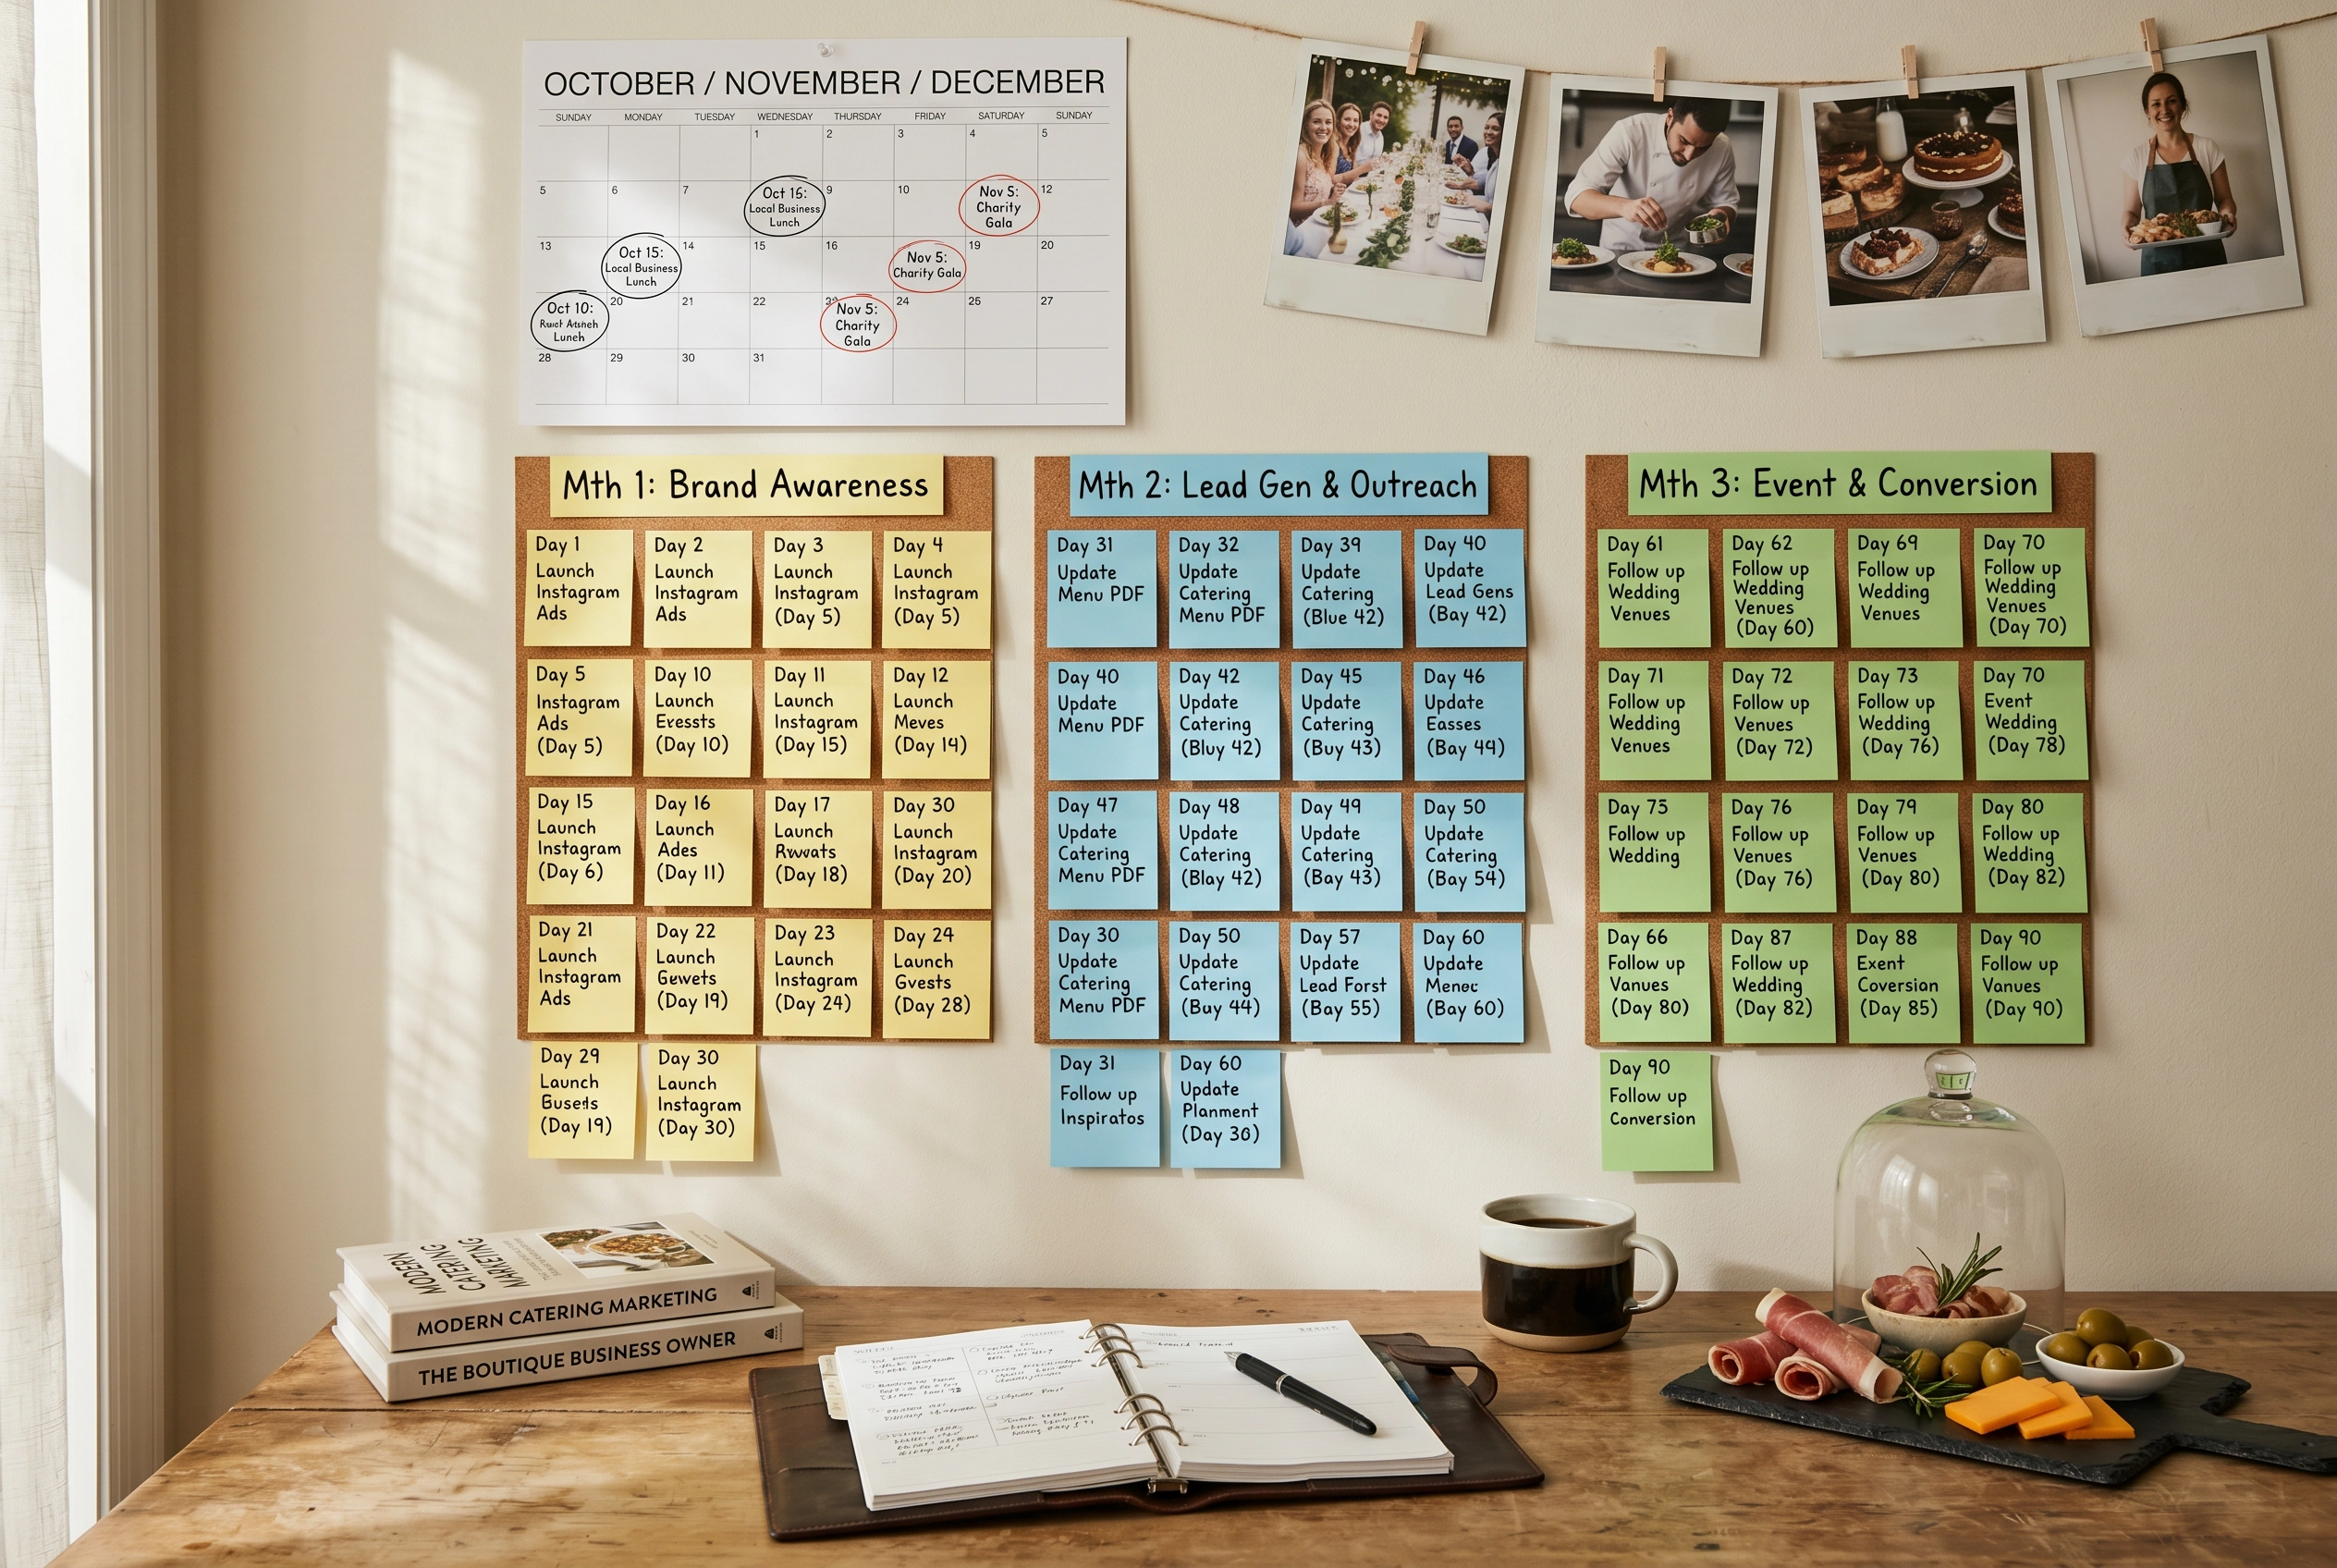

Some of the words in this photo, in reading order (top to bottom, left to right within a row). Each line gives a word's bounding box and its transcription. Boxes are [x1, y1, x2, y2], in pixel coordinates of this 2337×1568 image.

[545, 72, 694, 96] OCTOBER
[727, 71, 899, 95] NOVEMBER
[933, 69, 1104, 93] DECEMBER
[556, 113, 592, 122] SUNDAY
[624, 113, 663, 122] MONDAY
[694, 112, 736, 121] TUESDAY
[757, 112, 814, 121] WEDNESDAY
[833, 112, 883, 121] THURSDAY
[914, 112, 947, 121] FRIDAY
[978, 111, 1025, 120] SATURDAY
[1056, 111, 1094, 120] SUNDAY
[754, 129, 759, 139] 1
[826, 129, 833, 139] 2
[898, 129, 904, 139] 3
[969, 129, 976, 138] 4
[1041, 128, 1048, 138] 5
[539, 185, 546, 195] 5
[611, 185, 618, 195] 6
[682, 185, 690, 195] 7
[826, 185, 833, 195] 9
[898, 184, 910, 194] 10
[1041, 184, 1053, 194] 12
[750, 203, 775, 214] Local
[778, 203, 821, 214] Business
[976, 202, 1021, 215] Charity
[769, 216, 800, 227] Lunch
[985, 216, 1012, 227] Gala
[540, 240, 552, 251] 13
[619, 246, 642, 258] Oct
[646, 246, 664, 258] 15:
[682, 240, 694, 251] 14
[753, 240, 766, 251] 15
[826, 240, 838, 251] 16
[969, 240, 981, 251] 19
[1041, 239, 1054, 250] 20
[907, 251, 932, 263] Nov
[936, 251, 948, 263] 5:
[606, 263, 632, 273] Local
[635, 263, 679, 273] Business
[893, 267, 934, 280] Charity
[937, 267, 961, 278] Gala
[626, 276, 657, 287] Lunch
[610, 296, 623, 306] 20
[681, 296, 693, 306] 21
[752, 296, 766, 306] 22
[837, 302, 861, 314] Nov
[865, 302, 877, 314] 5:
[896, 296, 910, 306] 24
[1040, 296, 1054, 306] 27
[836, 320, 880, 334] Charity
[844, 336, 871, 347] Gala
[538, 352, 552, 362] 28
[610, 352, 624, 362] 29
[681, 352, 695, 362] 30
[564, 470, 621, 499] Mth
[636, 471, 655, 499] 1:
[670, 469, 756, 498] Brand
[771, 468, 928, 498] Awareness
[1080, 471, 1132, 499] Mth
[1146, 471, 1170, 498] 2:
[1184, 470, 1246, 498] Lead
[1260, 470, 1310, 498] Gen
[1323, 470, 1339, 498] &
[1352, 470, 1476, 498] Outreach
[1641, 469, 1697, 498] Mth
[1712, 468, 1740, 497] 3:
[1755, 468, 1836, 497] Event
[1849, 468, 1866, 496] &
[1879, 467, 2037, 496] Conversion
[536, 536, 567, 557] Day
[575, 536, 579, 551] 1
[894, 537, 924, 558] Day
[934, 537, 942, 552] 4
[1058, 537, 1089, 558] Day
[1097, 537, 1111, 552] 31
[1302, 537, 1332, 558] Day
[1340, 537, 1360, 552] 39
[537, 562, 593, 578] Launch
[895, 563, 952, 579] Launch
[1058, 564, 1116, 584] Update
[1303, 563, 1360, 583] Update
[538, 583, 618, 604] Instagram
[895, 584, 978, 605] Instagram
[1058, 586, 1103, 602] Menu
[1111, 585, 1144, 601] PDF
[1303, 585, 1373, 606] Catering
[537, 605, 567, 619] Ads
[895, 607, 934, 630] (Day
[942, 606, 959, 626] 5)
[1304, 608, 1347, 627] (Blue
[1354, 607, 1384, 627] 42)
[1609, 668, 1640, 689] Day
[1647, 668, 1662, 682] 71
[1984, 668, 2015, 689] Day
[2023, 668, 2044, 682] 70
[1609, 693, 1658, 709] Follow
[1667, 699, 1685, 714] up
[1986, 692, 2033, 707] Event
[1609, 715, 1680, 736] Wedding
[1986, 713, 2056, 735] Wedding
[1611, 737, 1670, 753] Venues
[1989, 735, 2029, 758] (Day
[2036, 735, 2064, 755] 78)
[538, 793, 569, 815] Day
[577, 793, 593, 808] 15
[1302, 799, 1332, 820] Day
[1340, 799, 1360, 814] 49
[1858, 799, 1889, 820] Day
[1896, 799, 1916, 815] 79
[538, 819, 595, 834] Launch
[1302, 825, 1360, 845] Update
[1858, 826, 1908, 841] Follow
[1915, 831, 1934, 846] up
[539, 840, 620, 861] Instagram
[1303, 847, 1373, 867] Catering
[1858, 847, 1916, 863] Venues
[539, 862, 578, 885] (Day
[585, 862, 603, 881] 6)
[1304, 867, 1343, 890] (Bay
[1351, 867, 1380, 888] 43)
[1863, 868, 1903, 891] (Day
[1910, 867, 1939, 888] 80)
[659, 1049, 690, 1071] Day
[697, 1050, 718, 1064] 30
[1060, 1055, 1092, 1076] Day
[1099, 1055, 1114, 1070] 31
[1610, 1060, 1641, 1081] Day
[1648, 1060, 1670, 1074] 90
[659, 1075, 716, 1090] Launch
[1061, 1085, 1111, 1100] Follow
[1119, 1091, 1136, 1105] up
[1610, 1087, 1660, 1102] Follow
[1668, 1093, 1686, 1108] up
[659, 1096, 740, 1117] Instagram
[1062, 1109, 1144, 1131] Inspiratos
[1610, 1112, 1695, 1125] Conversion
[659, 1119, 698, 1141] (Day
[705, 1118, 734, 1137] 30)
[420, 1243, 486, 1291] CATERING
[458, 1237, 531, 1289] MARKETING
[383, 1252, 447, 1295] MODERN
[417, 1312, 503, 1337] MODERN
[508, 1301, 604, 1326] CATERING
[609, 1287, 717, 1314] MARKETING
[419, 1366, 458, 1387] THE
[463, 1353, 565, 1381] BOUTIQUE
[570, 1341, 660, 1366] BUSINESS
[666, 1331, 736, 1354] OWNER
